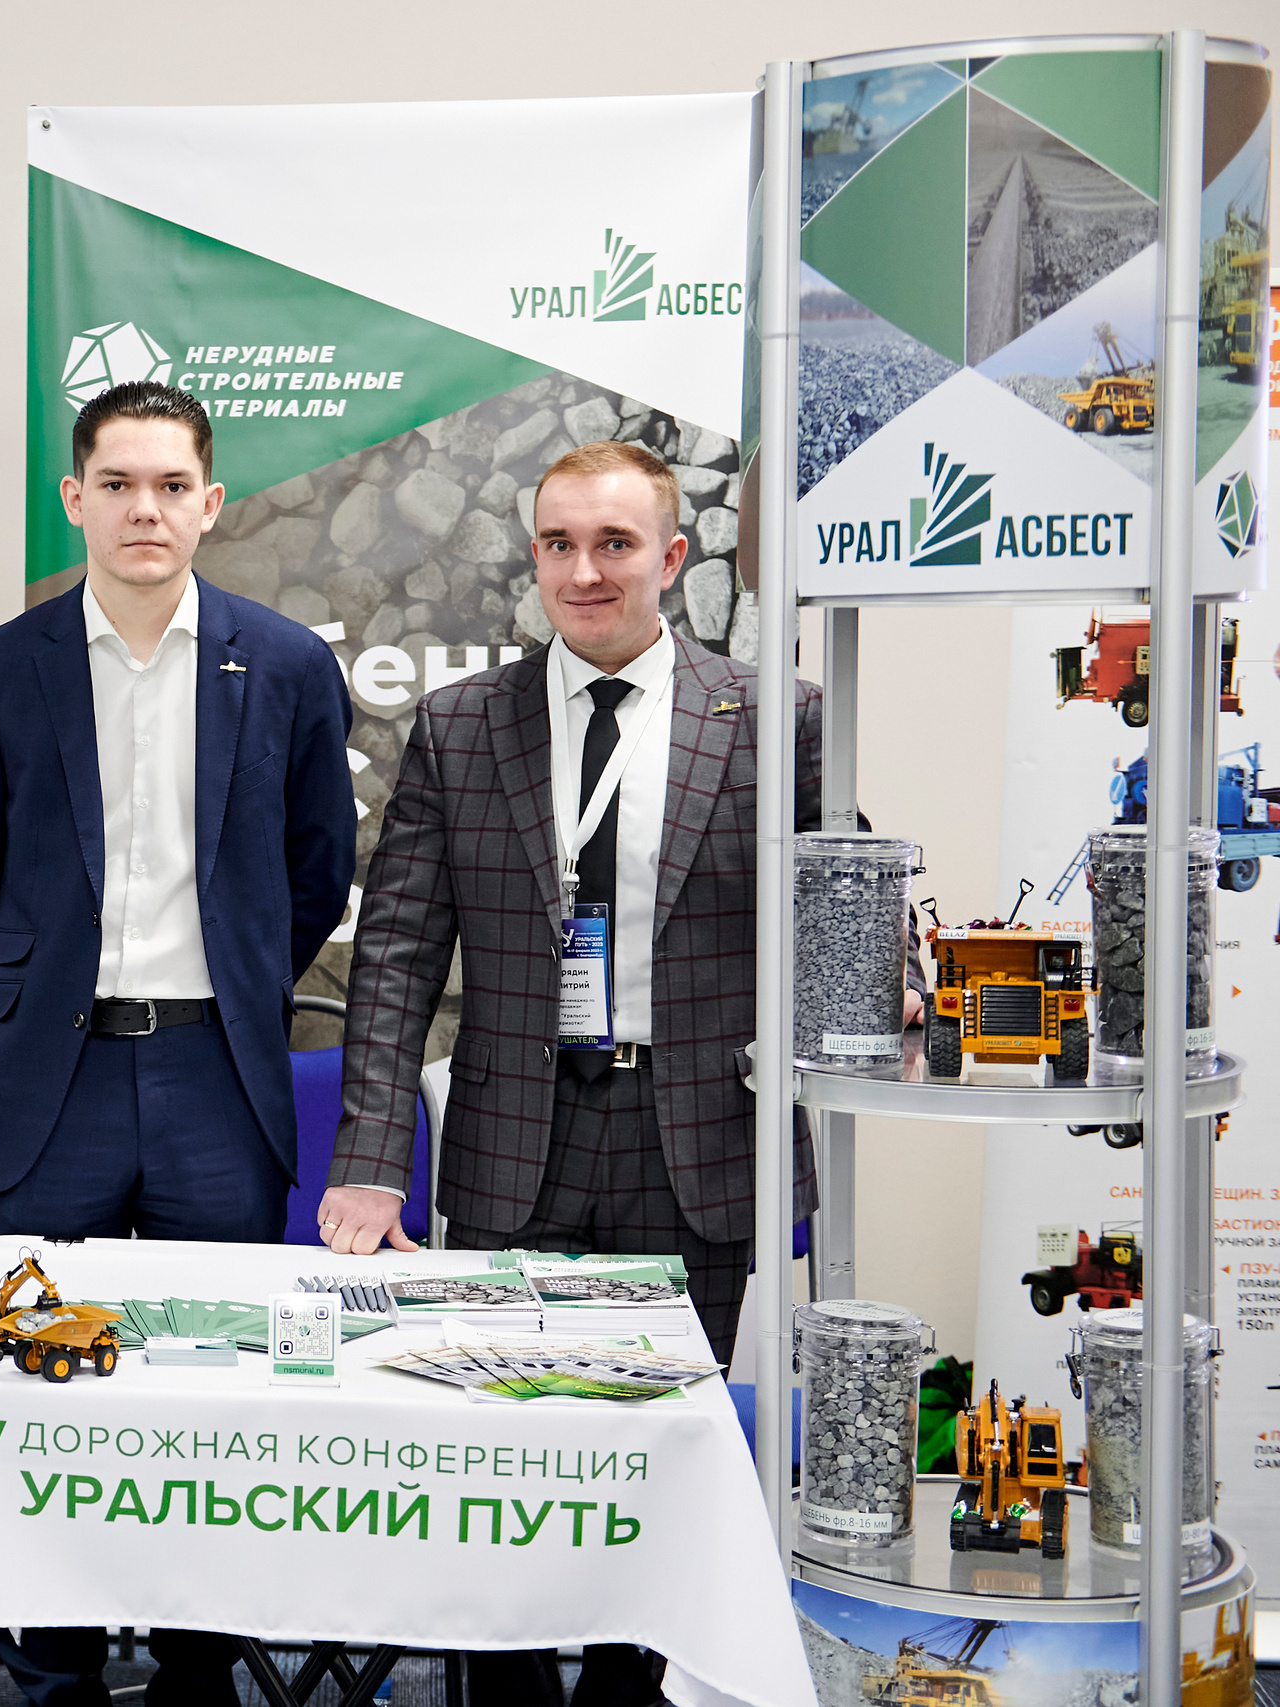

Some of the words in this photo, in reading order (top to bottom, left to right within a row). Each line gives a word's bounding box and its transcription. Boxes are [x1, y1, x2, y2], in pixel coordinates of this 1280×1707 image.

[510, 286, 586, 319] УРАЛ
[656, 282, 746, 316] АСБЕС
[185, 345, 336, 367] НЕРУДНЫЕ
[177, 372, 404, 391] СТРОИТЕЛЬНЫЕ
[202, 399, 347, 418] АТЕРИАЛЫ
[817, 519, 902, 565] УРАЛ
[995, 512, 1134, 558] АСБЕСТ
[1041, 921, 1092, 932] БАСТИ
[561, 969, 589, 977] рядин
[560, 980, 590, 990] итрий
[560, 1036, 599, 1044] УШАТЕЛЬ
[829, 1039, 871, 1051] ЩЕБЕНЬ
[1214, 1188, 1266, 1201] ЕЩИН.
[1240, 1263, 1280, 1275] ПЗУ-
[1237, 1279, 1280, 1288] ПЛАВИ
[1237, 1307, 1280, 1316] ЭЛЕКТР
[283, 1367, 325, 1375] nsmural.ru
[20, 1422, 278, 1462] ДОРОЖНАЯ
[299, 1434, 648, 1483] КОНФЕРЕНЦИЯ
[19, 1470, 429, 1541] УРАЛЬСКИЙ
[459, 1497, 641, 1547] ПУТЬ
[833, 1516, 871, 1528] фр.8-16
[874, 1521, 888, 1529] мм
